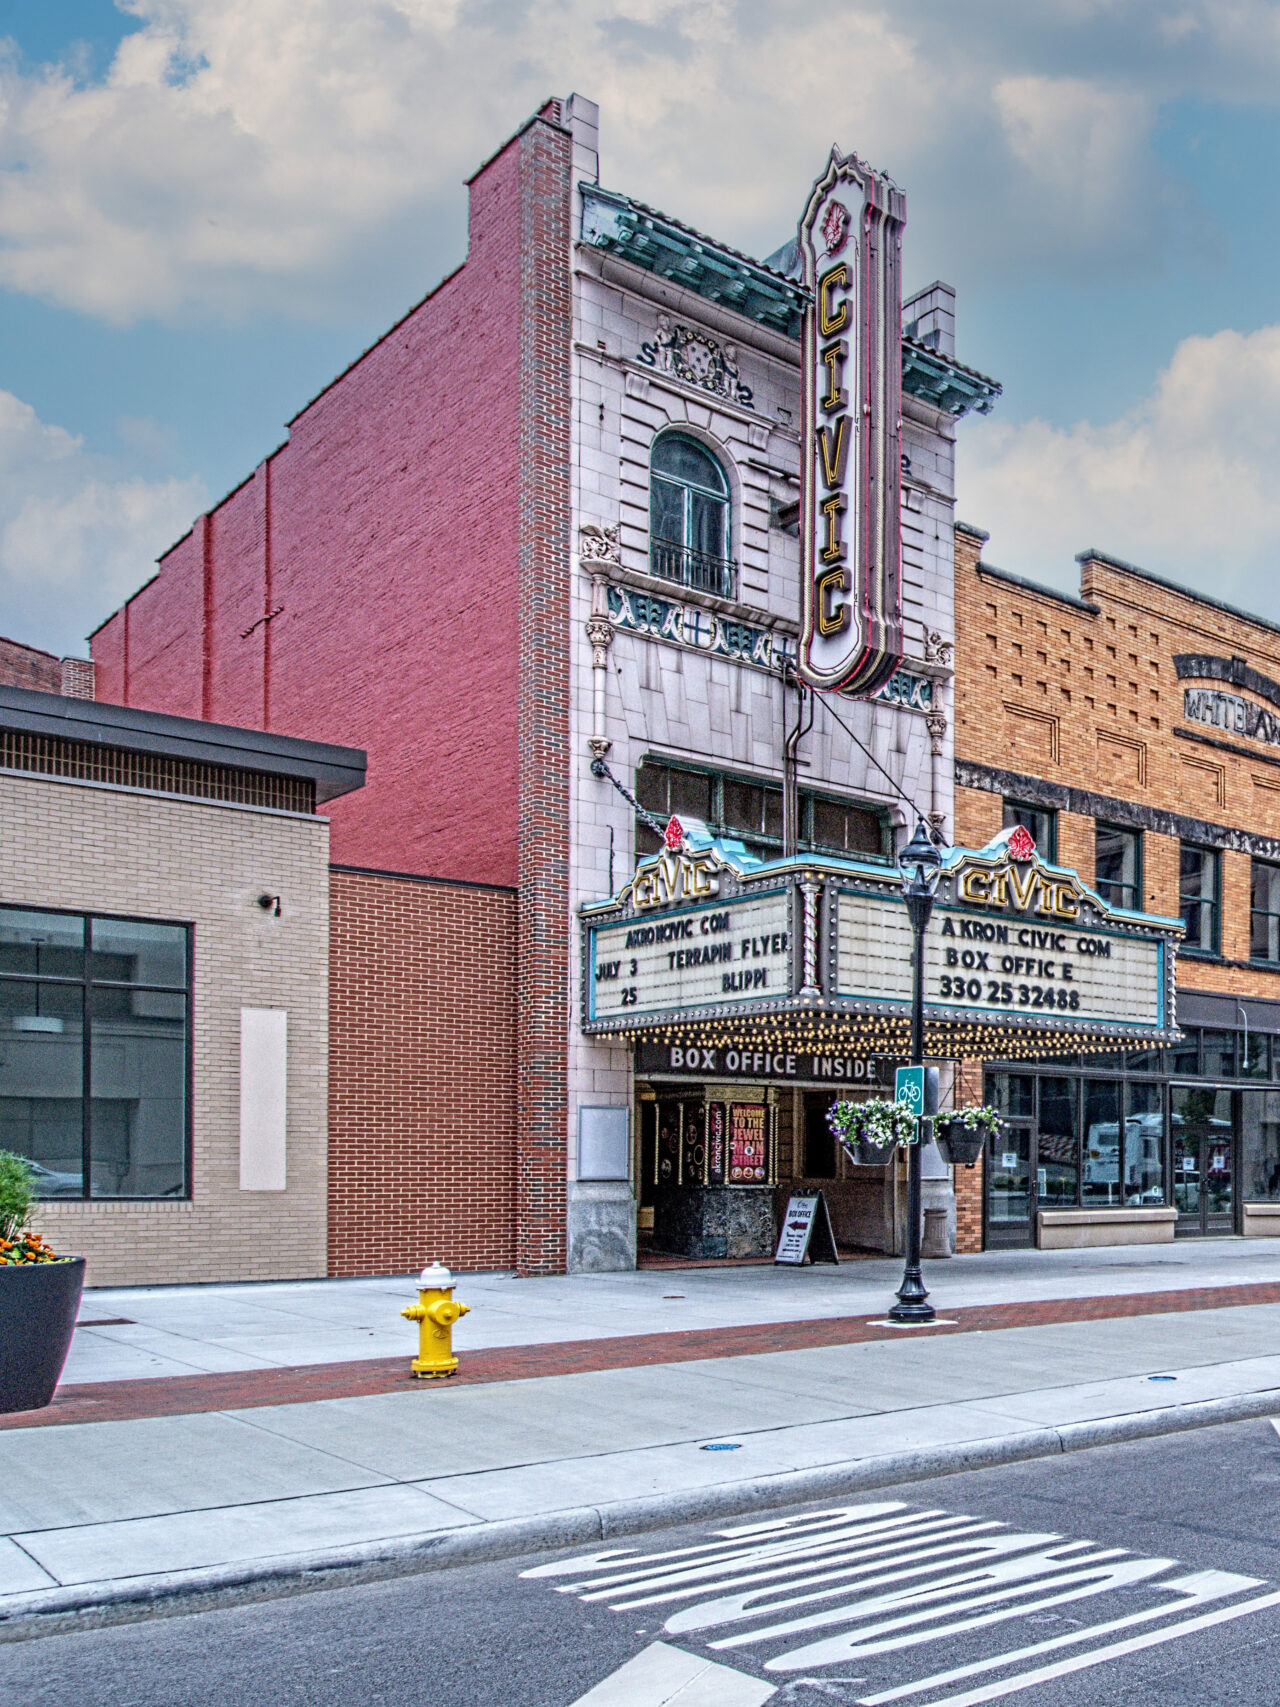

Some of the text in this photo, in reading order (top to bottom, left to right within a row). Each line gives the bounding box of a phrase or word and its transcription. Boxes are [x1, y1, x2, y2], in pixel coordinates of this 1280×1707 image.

[817, 261, 854, 640] CIVIC
[632, 856, 720, 909] CIVIC
[957, 864, 1081, 919] CIVIC
[700, 911, 730, 935] COM
[942, 917, 1112, 960] AKRON CIVIC COM
[595, 932, 788, 981] JULY 3 TERRAPIN FLYER
[946, 947, 1074, 981] BOX OFFICE
[621, 987, 637, 1006] 25
[670, 1047, 877, 1079] BOX OFFICE INSIDE
[732, 1108, 766, 1118] WELCOME
[733, 1117, 765, 1129] TO THE
[711, 1110, 723, 1174] akroncivic.com
[733, 1128, 765, 1141] JEWEL
[731, 1155, 765, 1166] STREET
[798, 1210, 812, 1219] OFFICE
